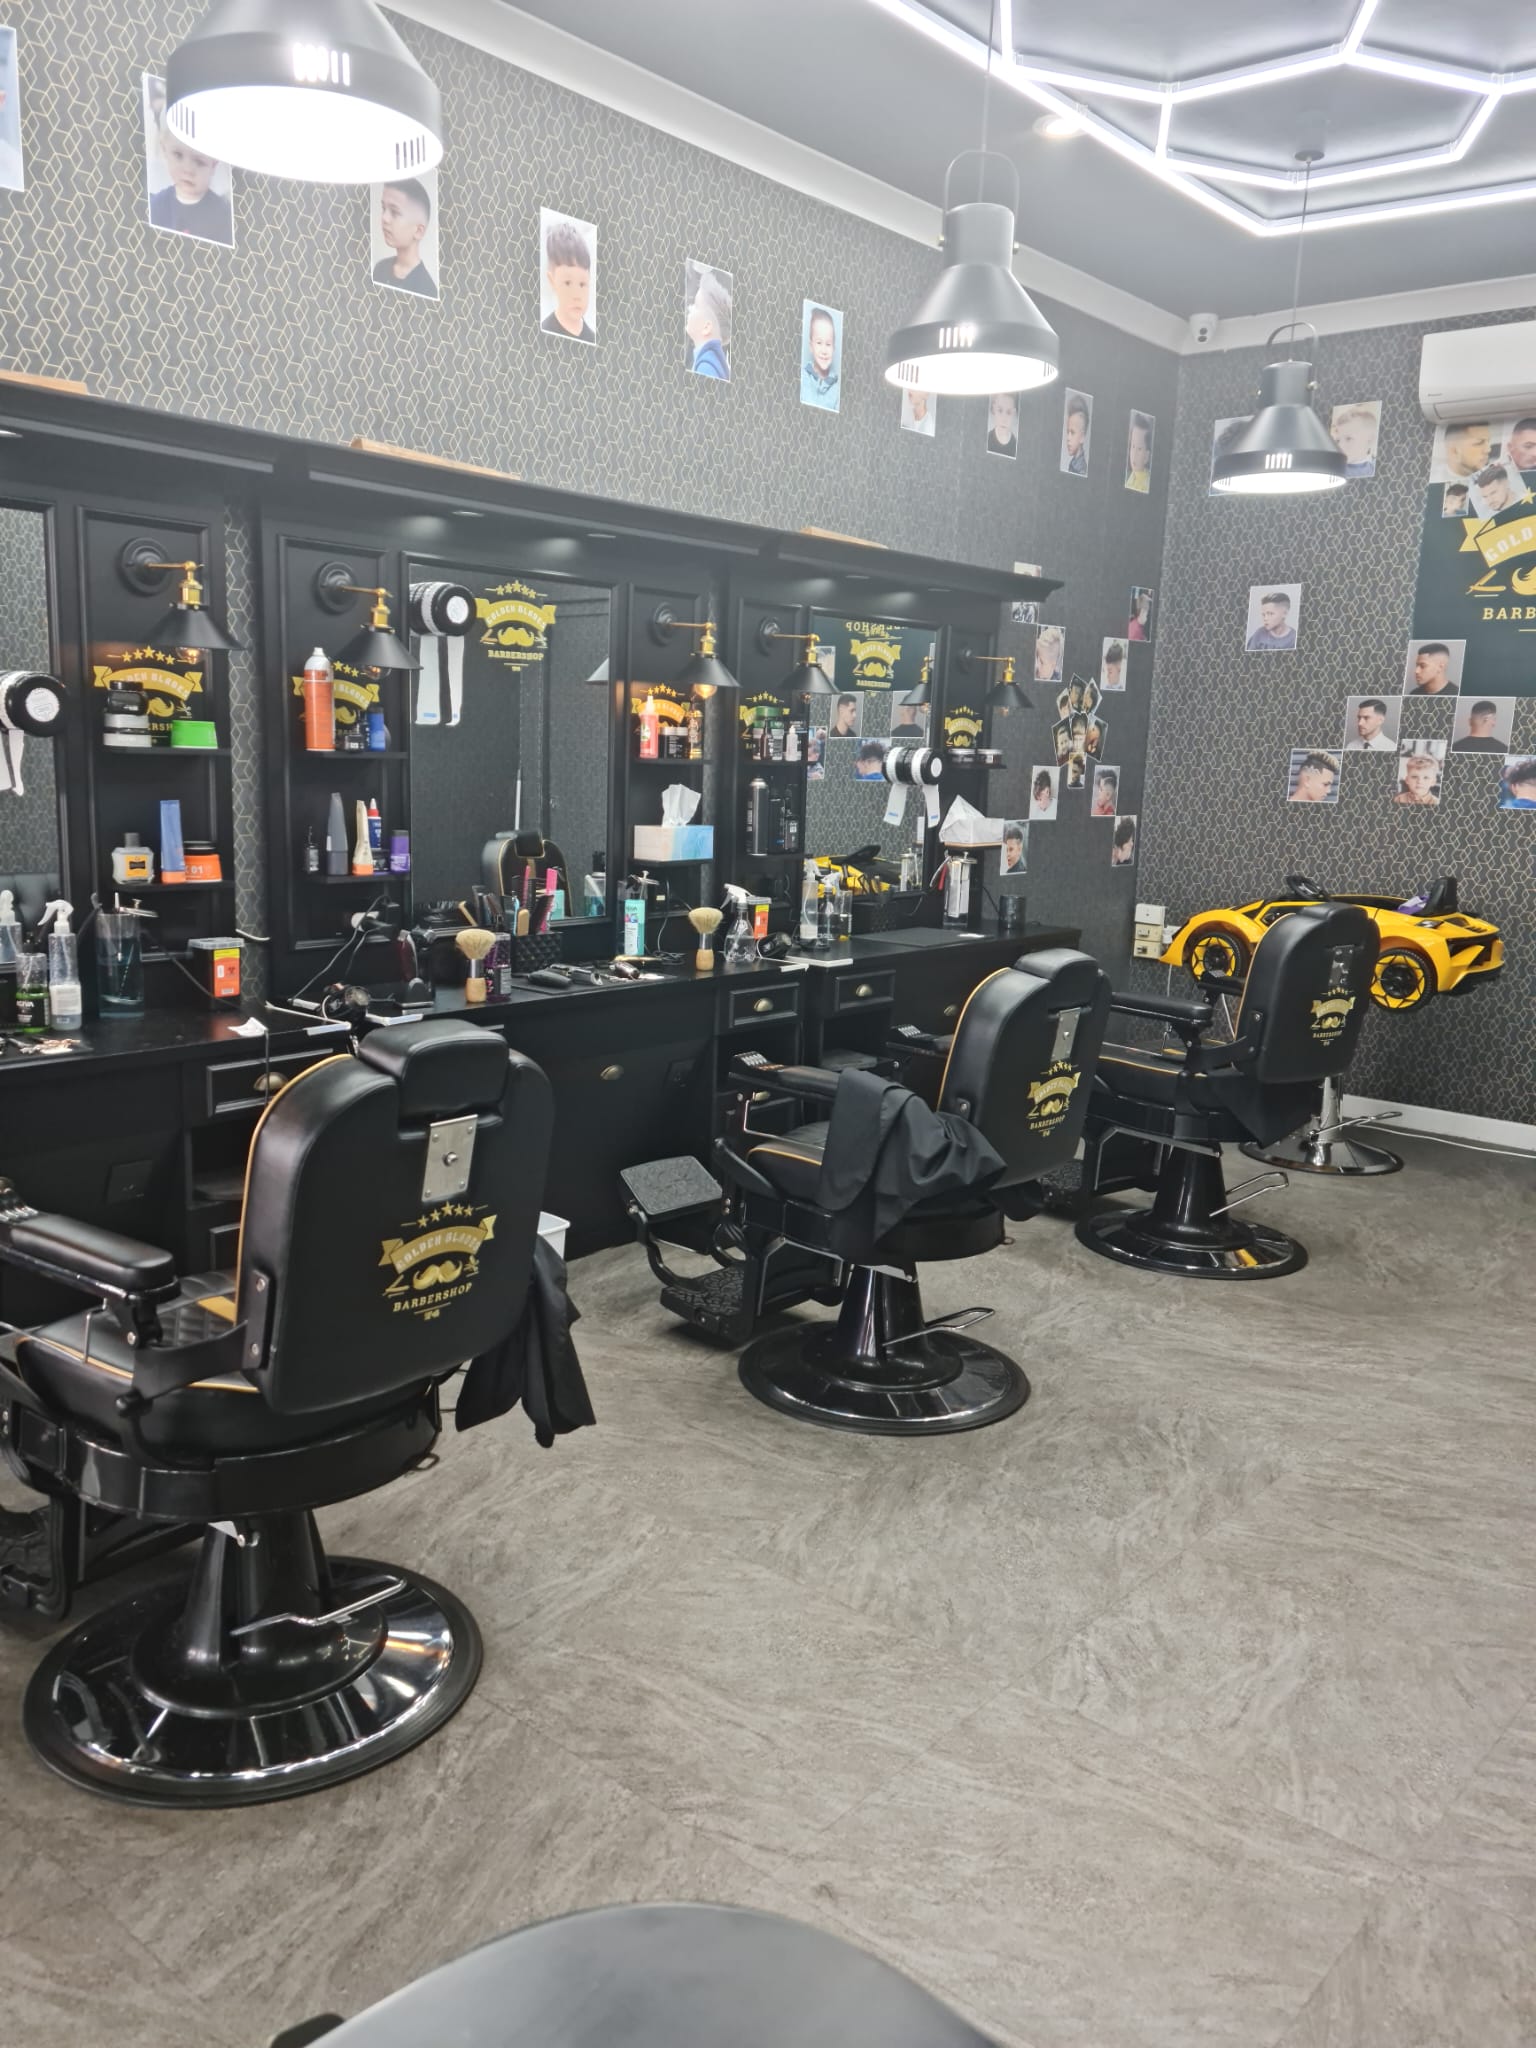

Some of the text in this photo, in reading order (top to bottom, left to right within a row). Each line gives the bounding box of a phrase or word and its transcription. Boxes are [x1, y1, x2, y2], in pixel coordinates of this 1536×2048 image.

[486, 605, 515, 625] GOLDEN
[488, 650, 544, 661] BARBERSHOP
[395, 1232, 482, 1269] GOLDEN BLADES
[393, 1282, 473, 1313] BARBERSHOP
